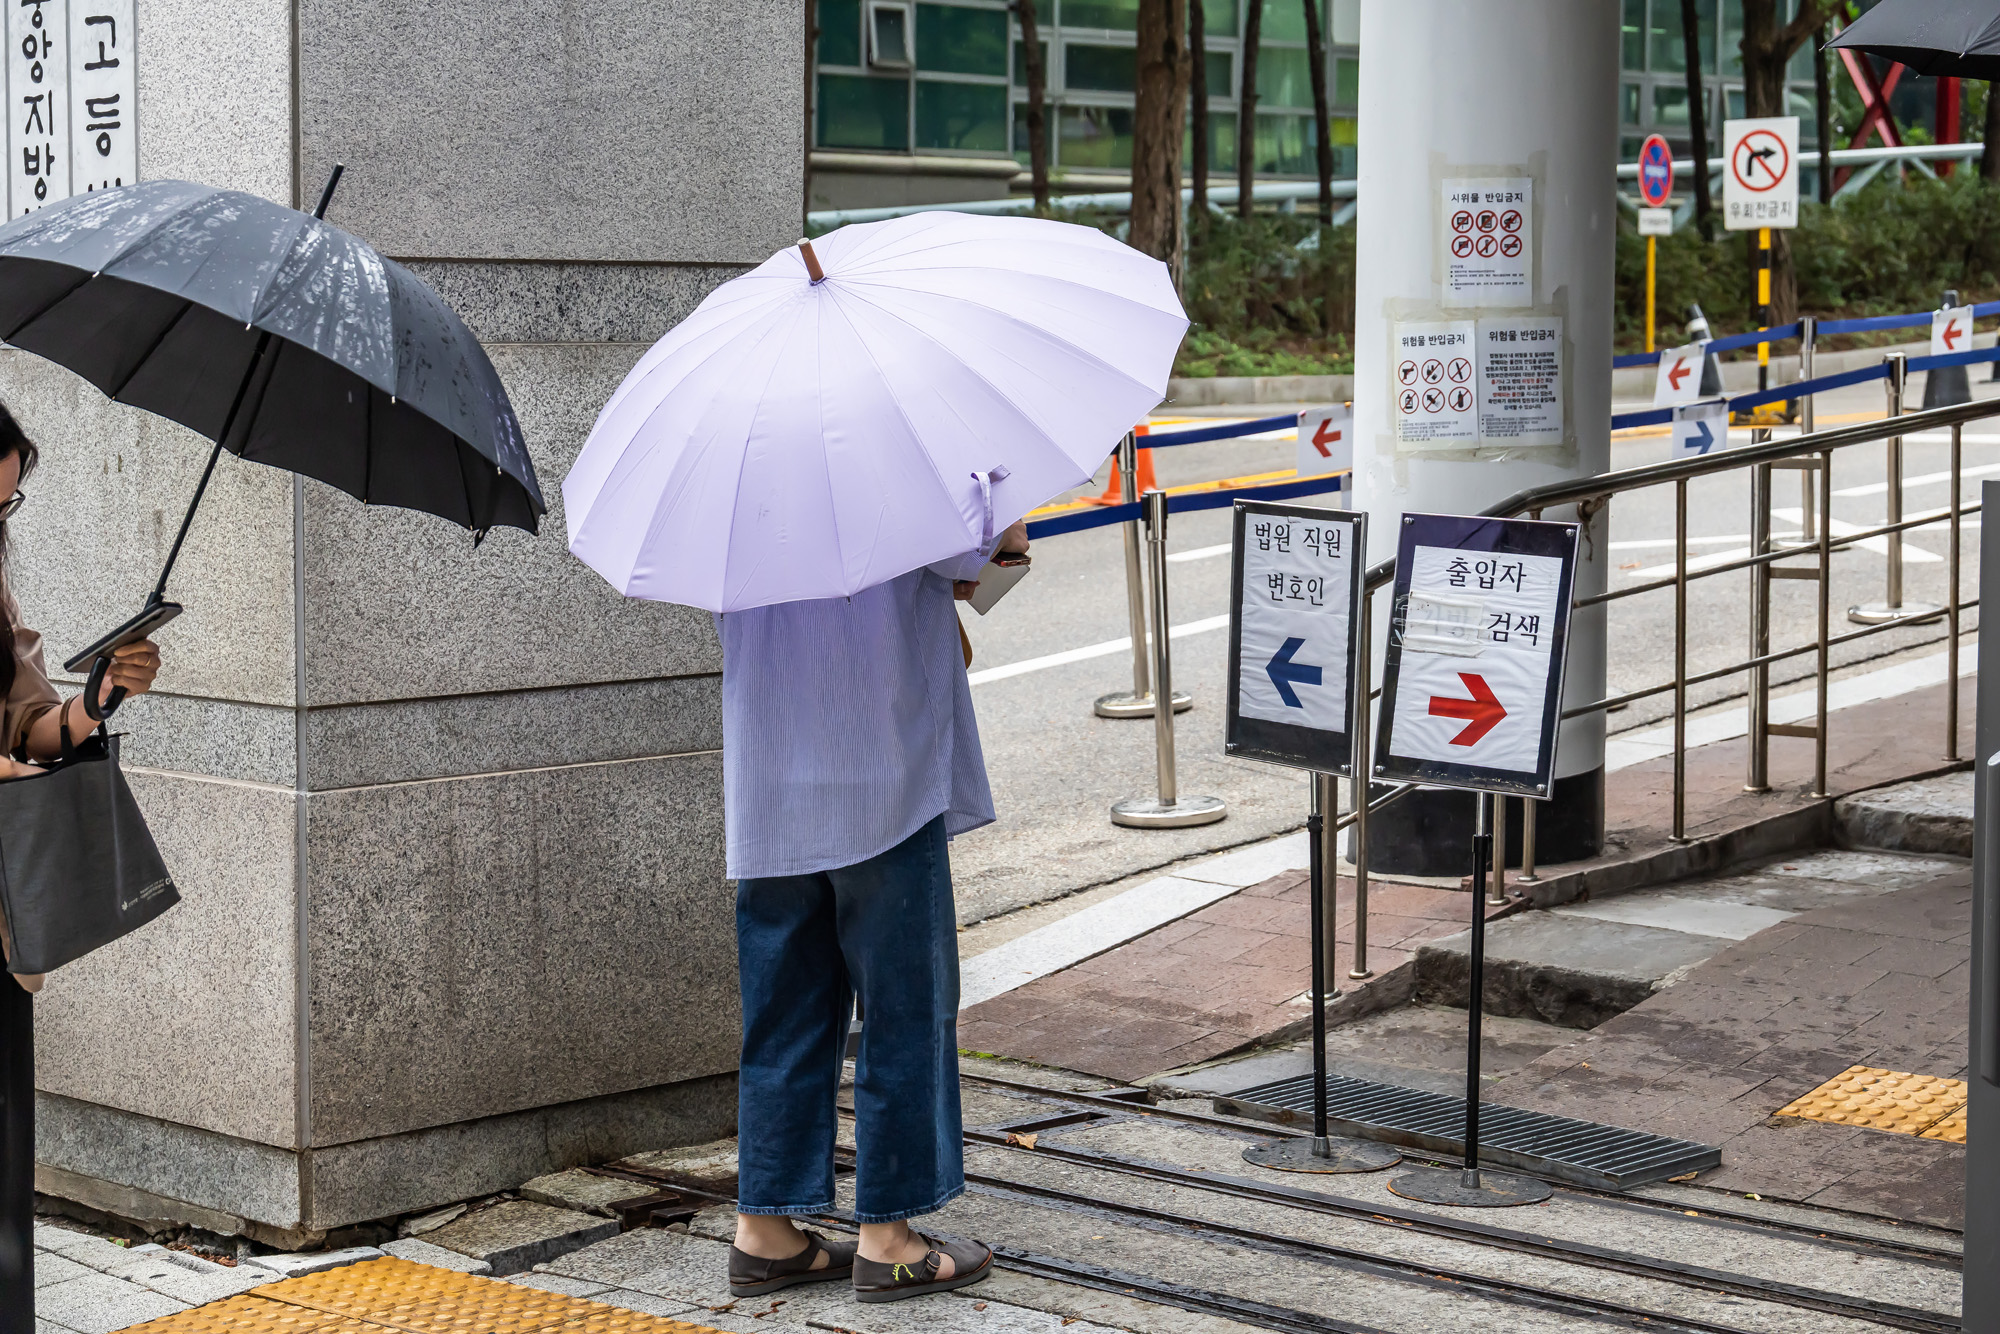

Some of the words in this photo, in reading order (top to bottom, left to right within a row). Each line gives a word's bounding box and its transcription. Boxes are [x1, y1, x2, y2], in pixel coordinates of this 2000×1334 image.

[84, 15, 121, 192] 고등
[1451, 193, 1479, 203] 시위물
[1485, 192, 1523, 203] 반입금지
[1730, 201, 1792, 219] 우회전금지
[1402, 335, 1426, 347] 위험물
[1428, 334, 1465, 345] 반입금지
[1489, 330, 1517, 342] 위험물
[1521, 329, 1555, 341] 반입금지
[1255, 522, 1291, 553] 법원
[1303, 526, 1341, 558] 직원
[1267, 573, 1324, 606] 변호인
[1446, 557, 1527, 592] 출입자
[1487, 612, 1540, 646] 검색
